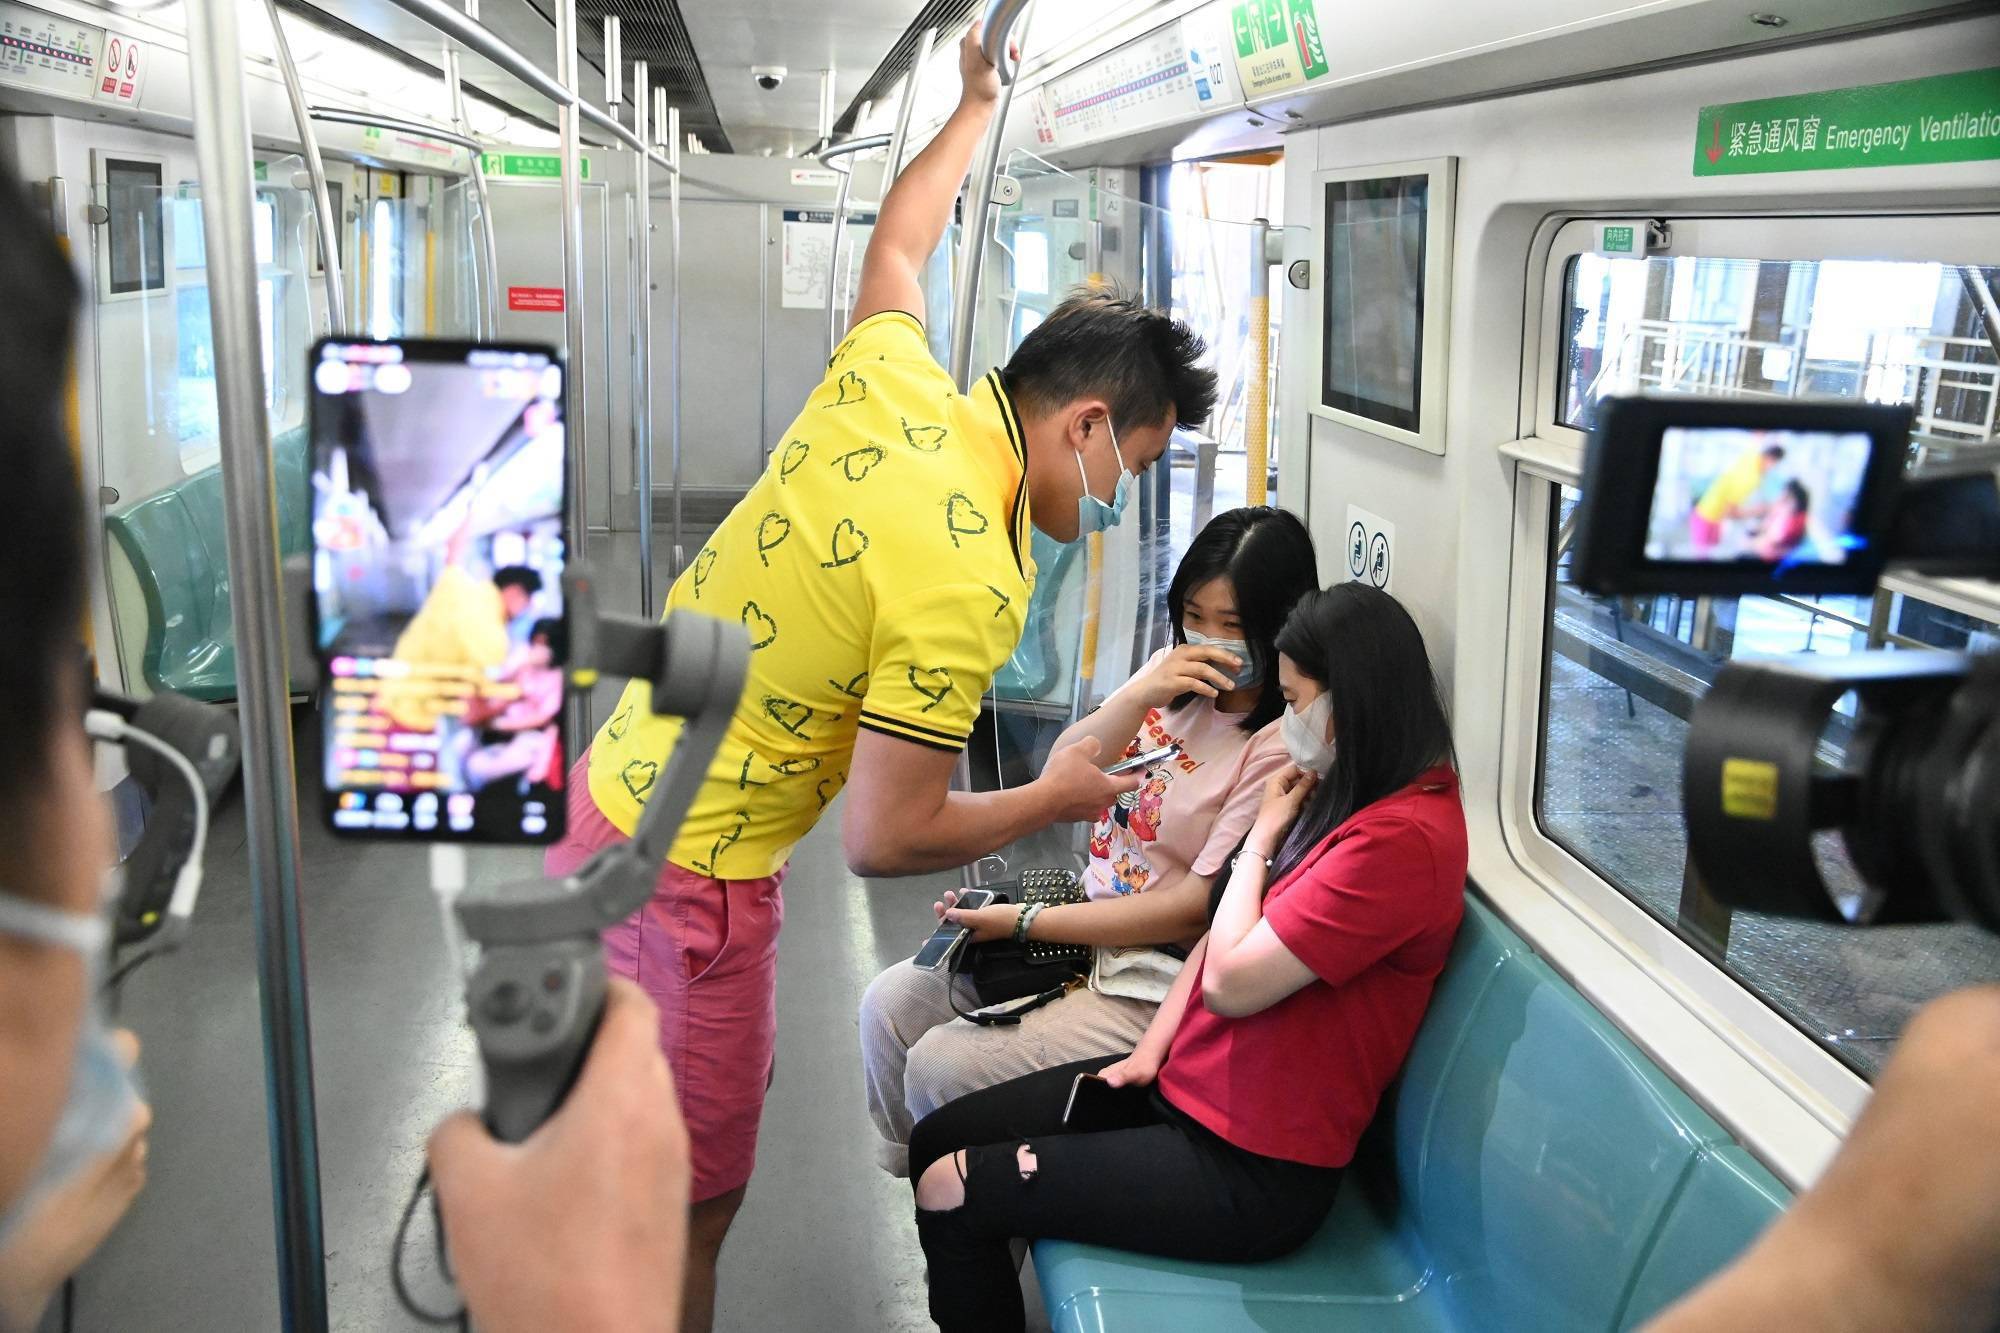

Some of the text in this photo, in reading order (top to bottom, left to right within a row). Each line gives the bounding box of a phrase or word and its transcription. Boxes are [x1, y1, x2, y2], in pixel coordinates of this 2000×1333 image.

[1728, 114, 1821, 157] 紧急通风窗
[1825, 125, 1912, 154] Emergency
